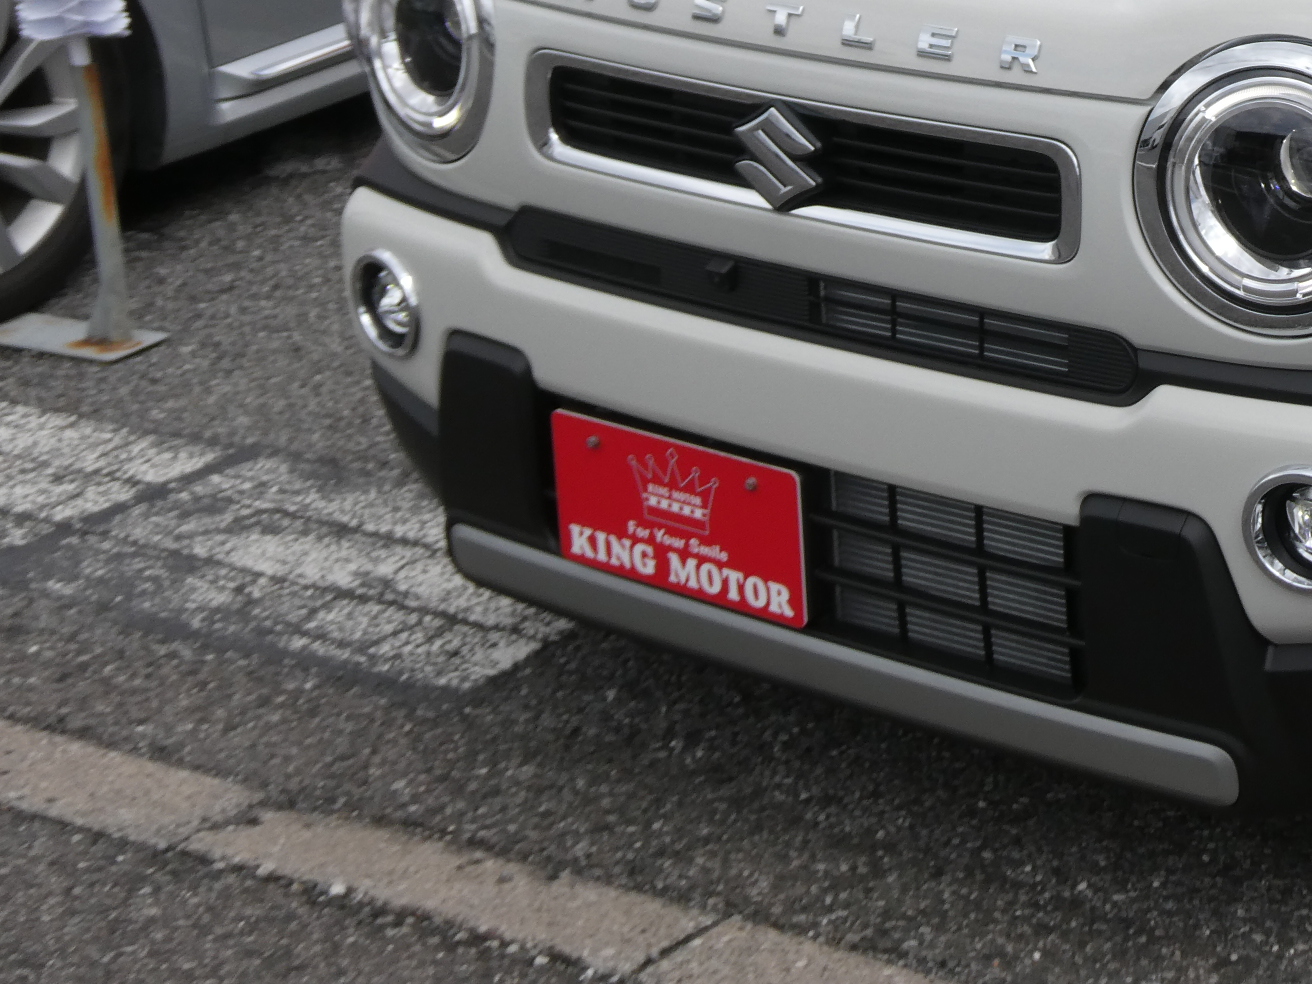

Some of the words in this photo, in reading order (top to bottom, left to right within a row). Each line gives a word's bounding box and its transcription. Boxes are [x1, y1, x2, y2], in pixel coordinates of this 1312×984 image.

[568, 523, 657, 576] KING
[667, 551, 795, 618] MOTOR
[627, 520, 651, 539] For
[653, 527, 686, 550] Your
[688, 537, 729, 563] Smile
